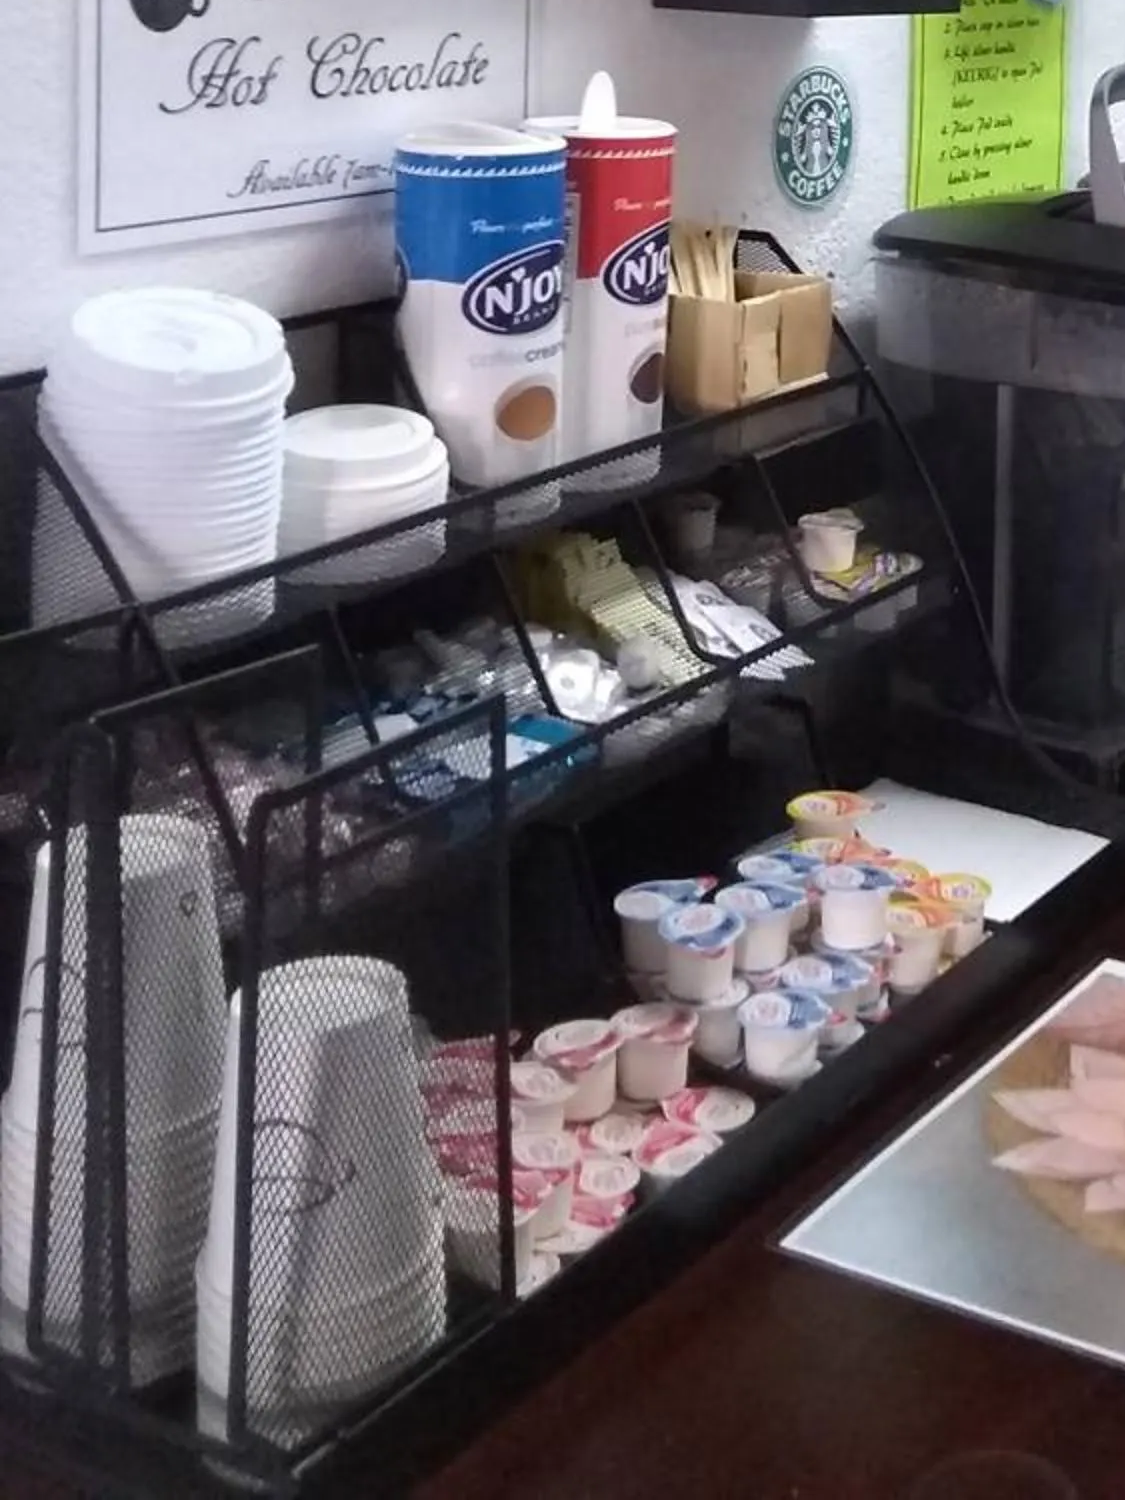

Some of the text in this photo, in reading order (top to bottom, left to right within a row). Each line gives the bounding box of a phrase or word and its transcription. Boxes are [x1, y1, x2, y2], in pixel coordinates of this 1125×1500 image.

[158, 31, 491, 116] Hot Chocolate
[777, 73, 850, 137] STARBUCKS
[225, 153, 342, 199] Available
[788, 160, 844, 200] COFFEE
